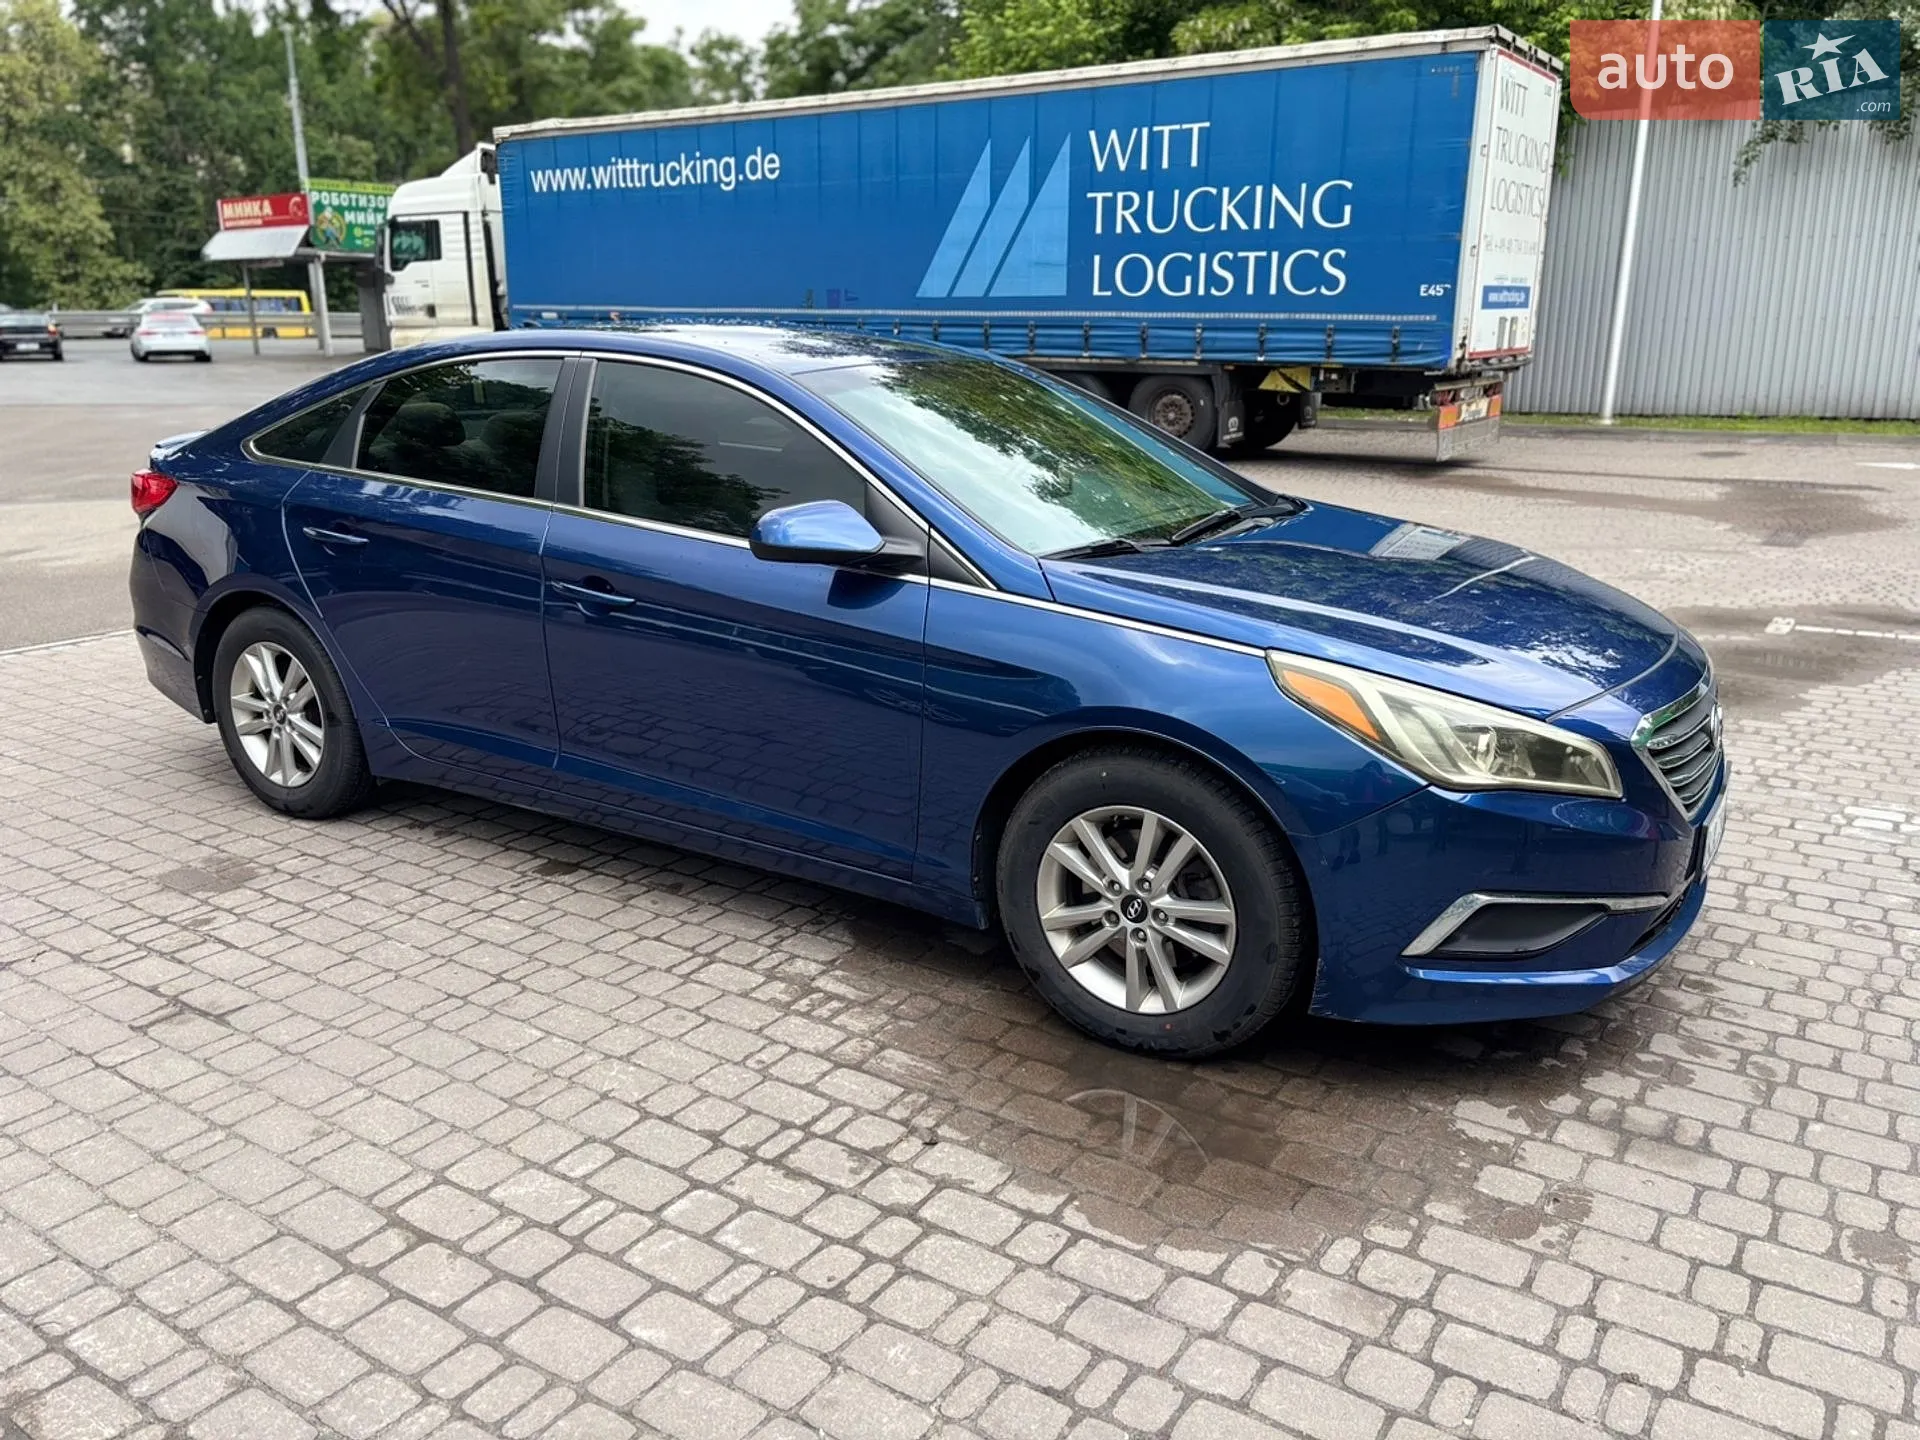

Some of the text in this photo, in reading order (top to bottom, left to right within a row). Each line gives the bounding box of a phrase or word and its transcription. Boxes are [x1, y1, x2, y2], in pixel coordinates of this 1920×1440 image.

[1500, 75, 1528, 118] WITT
[530, 146, 780, 193] www.witttrucking.de
[1088, 121, 1210, 172] WITT
[1086, 180, 1353, 234] TRUCKING
[1092, 249, 1347, 297] LOGISTICS
